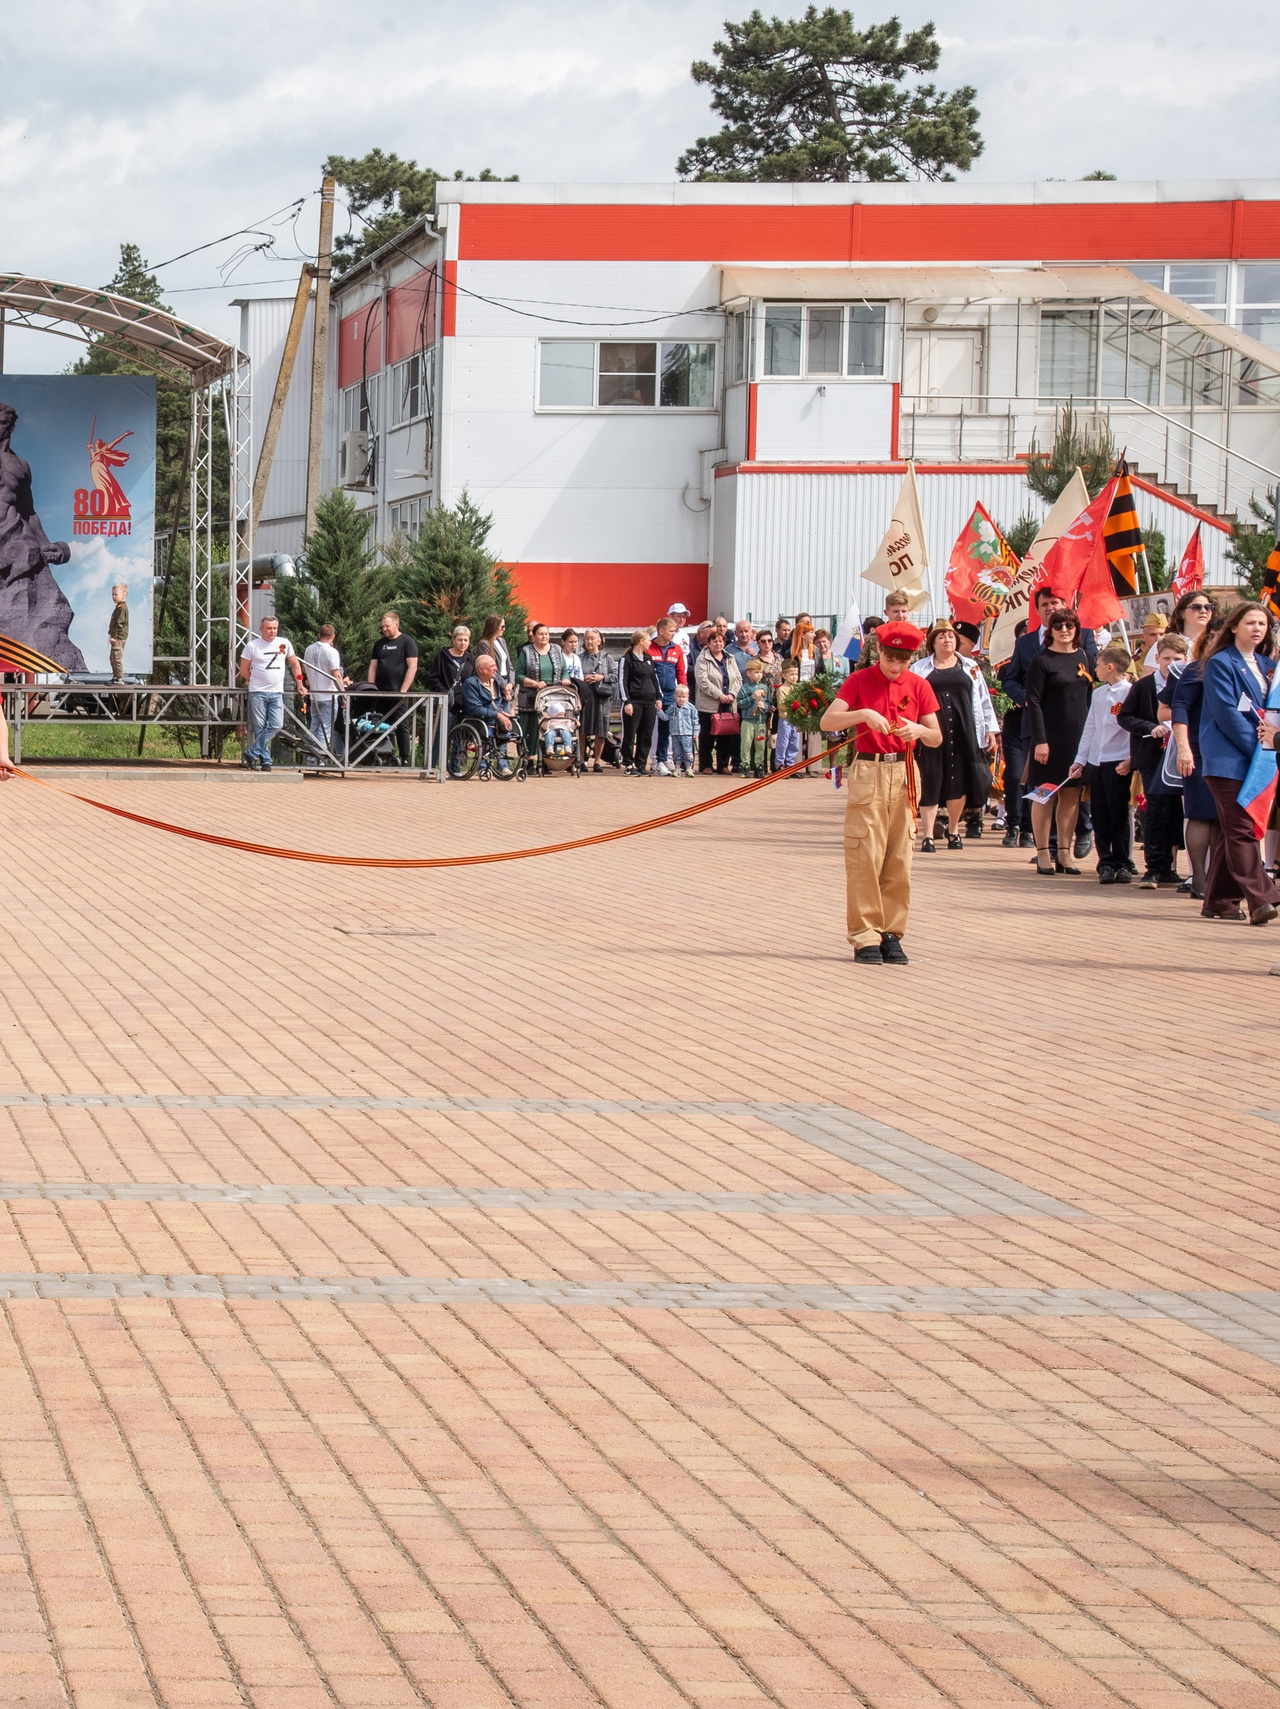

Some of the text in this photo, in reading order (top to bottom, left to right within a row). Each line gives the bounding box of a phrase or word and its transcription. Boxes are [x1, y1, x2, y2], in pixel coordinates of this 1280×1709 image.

[73, 488, 105, 516] 80
[73, 521, 132, 537] ПОБЕДА!
[263, 651, 281, 670] Z
